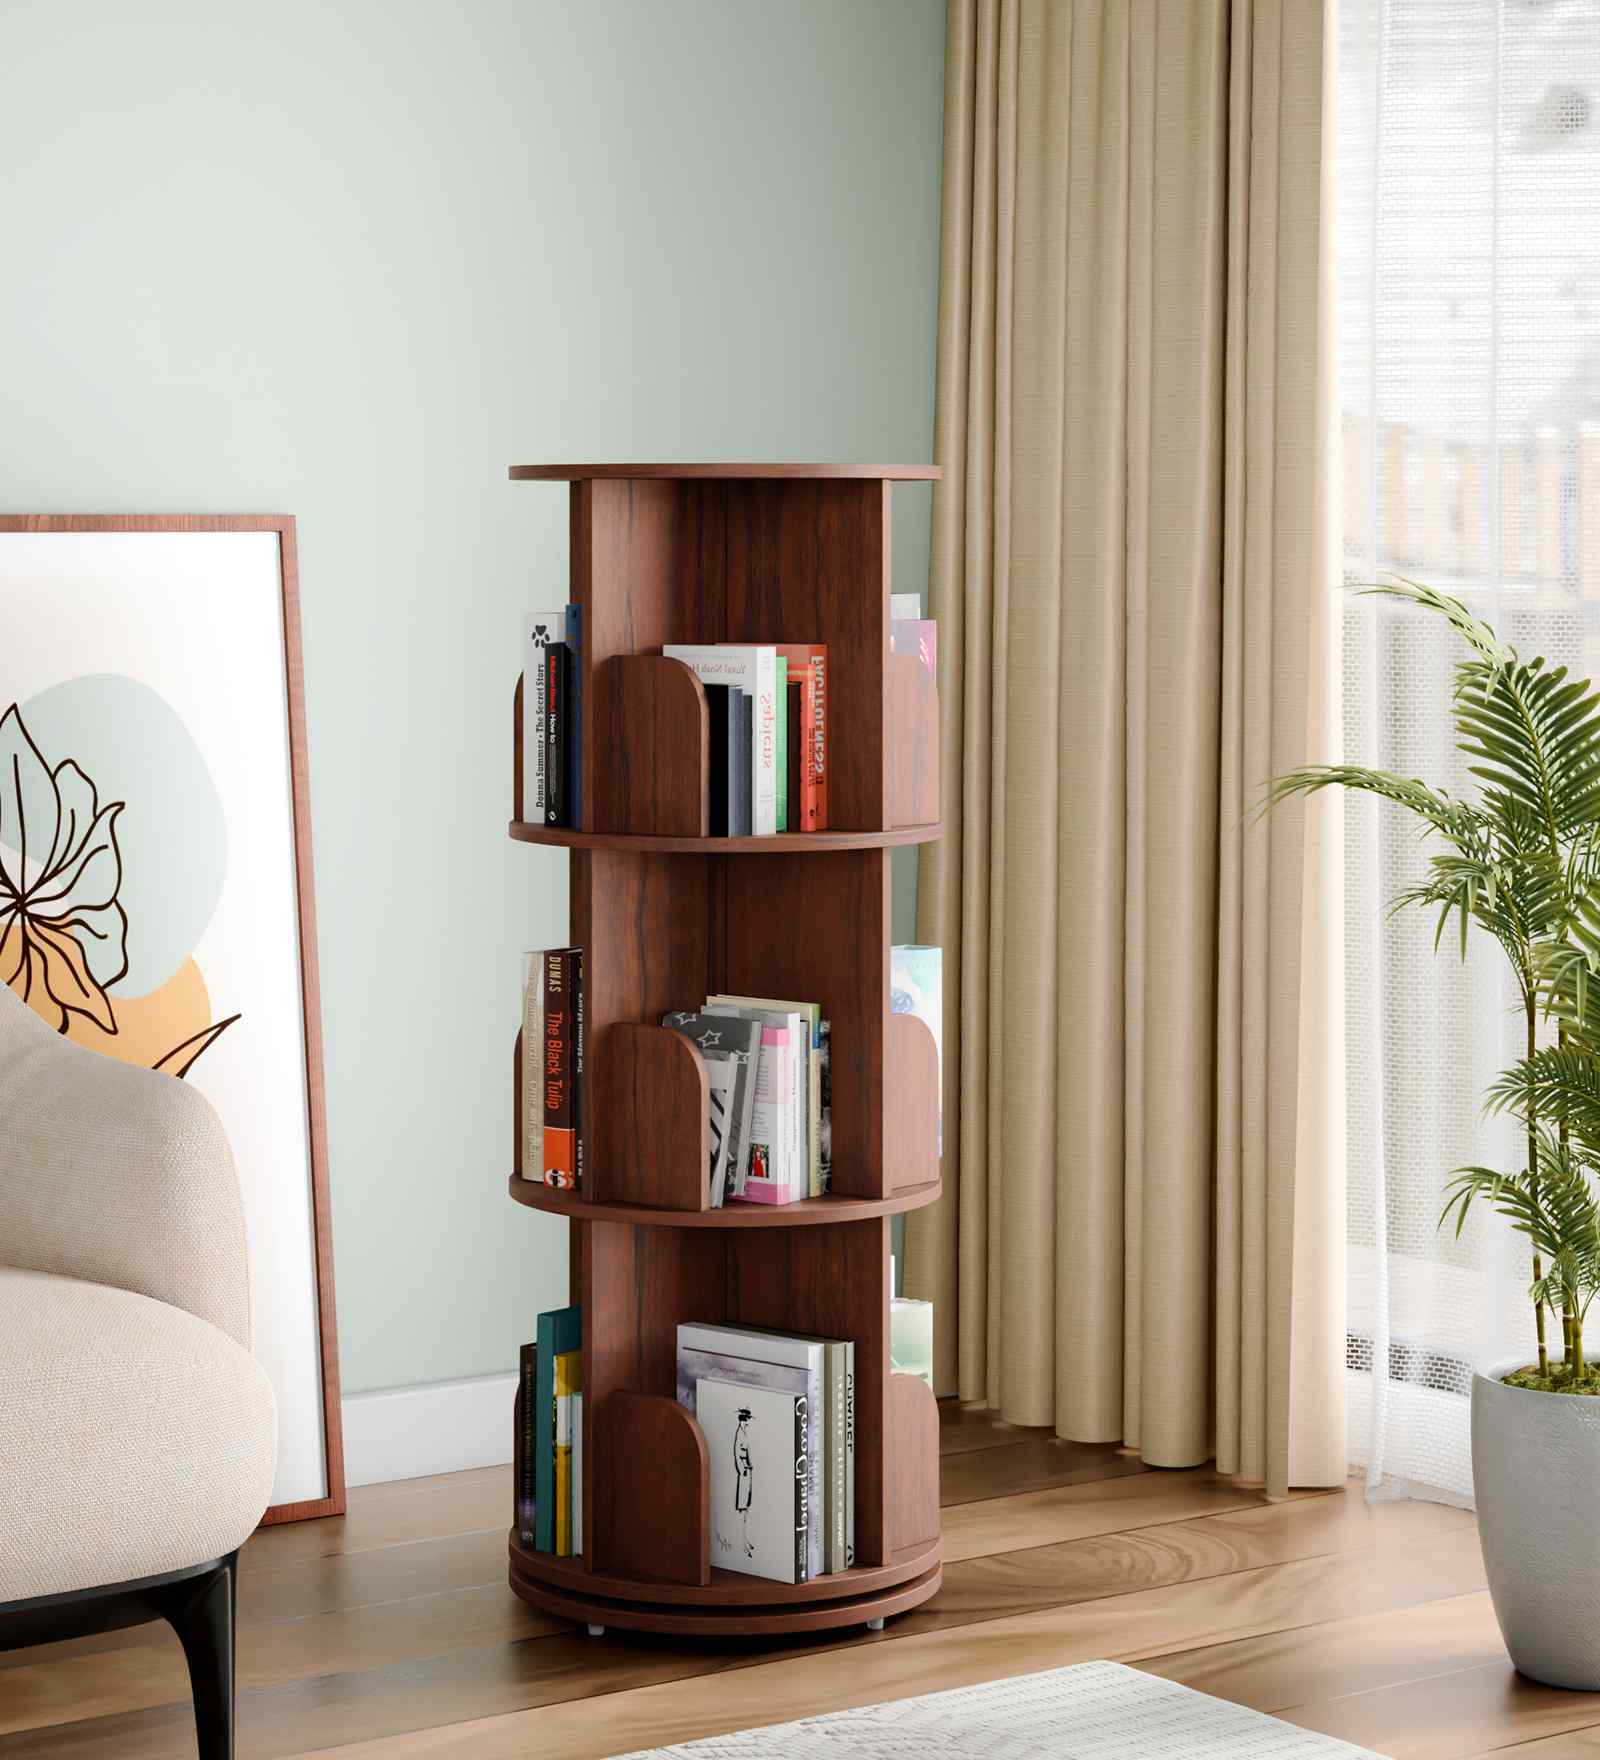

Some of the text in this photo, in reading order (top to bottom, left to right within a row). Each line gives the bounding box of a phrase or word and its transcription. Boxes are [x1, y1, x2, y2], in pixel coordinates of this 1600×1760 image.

[535, 664, 545, 808] Donna Summer The Secret Story
[549, 713, 557, 733] How
[549, 733, 557, 744] to
[549, 955, 562, 993] DUMAS
[545, 1012, 563, 1110] The Black Tulip
